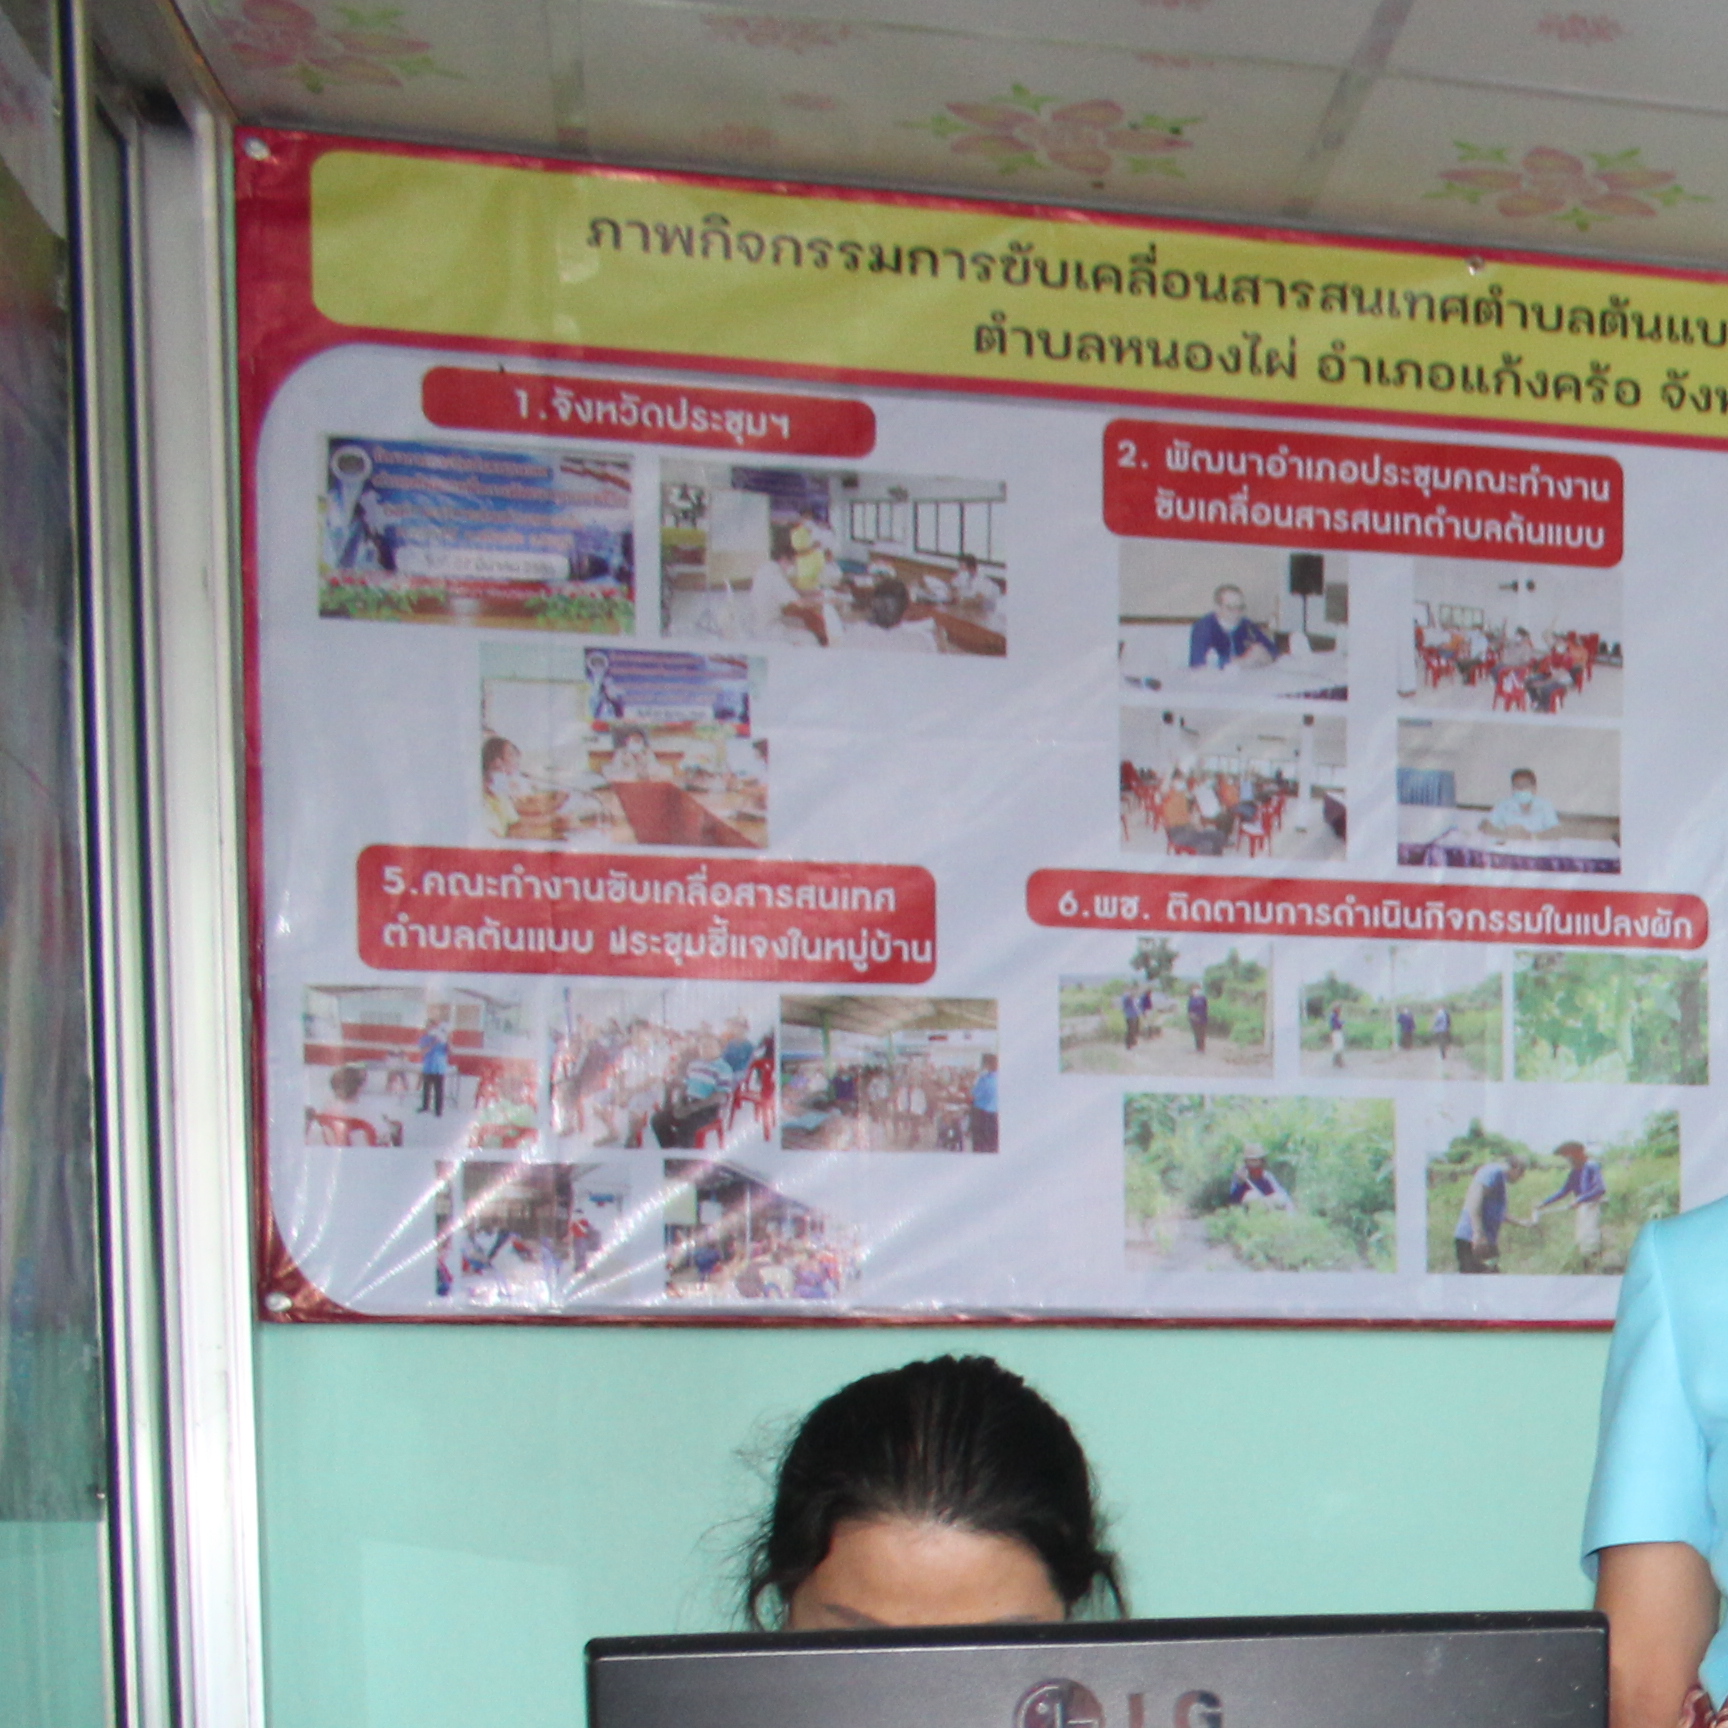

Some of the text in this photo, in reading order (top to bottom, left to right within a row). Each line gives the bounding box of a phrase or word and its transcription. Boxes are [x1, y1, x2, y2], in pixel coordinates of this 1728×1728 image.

[974, 310, 1298, 380] ตำบลหนองไผ่
[1317, 340, 1642, 409] อำเภอแก้งคร้อ
[1165, 437, 1611, 502] พัฒนาอำเภอประชุมคณะทำงาน
[382, 912, 932, 973] ตำบลต้นแบบ ประชุมชี้แจงในหมู่บ้าน
[1166, 890, 1694, 940] ติดตามการดำเนินกิจกรรมในแปลงผัก
